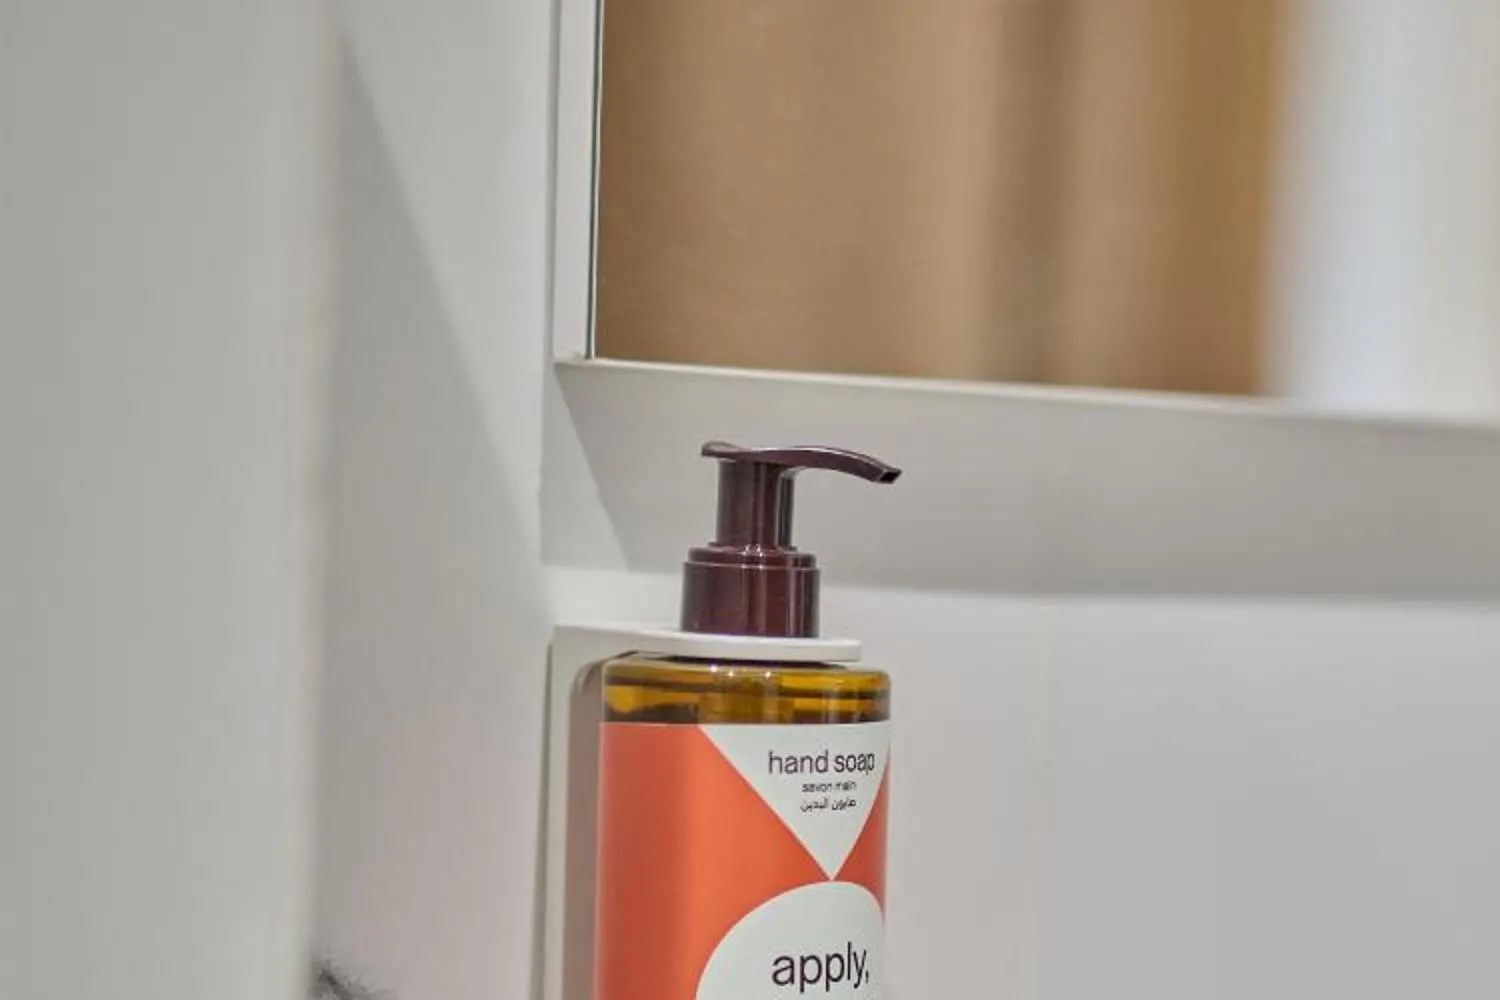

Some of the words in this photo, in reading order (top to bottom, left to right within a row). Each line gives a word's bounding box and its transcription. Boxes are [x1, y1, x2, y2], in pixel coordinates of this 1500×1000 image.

[768, 749, 829, 774] hand
[833, 752, 876, 776] soap
[771, 941, 870, 993] apply,
